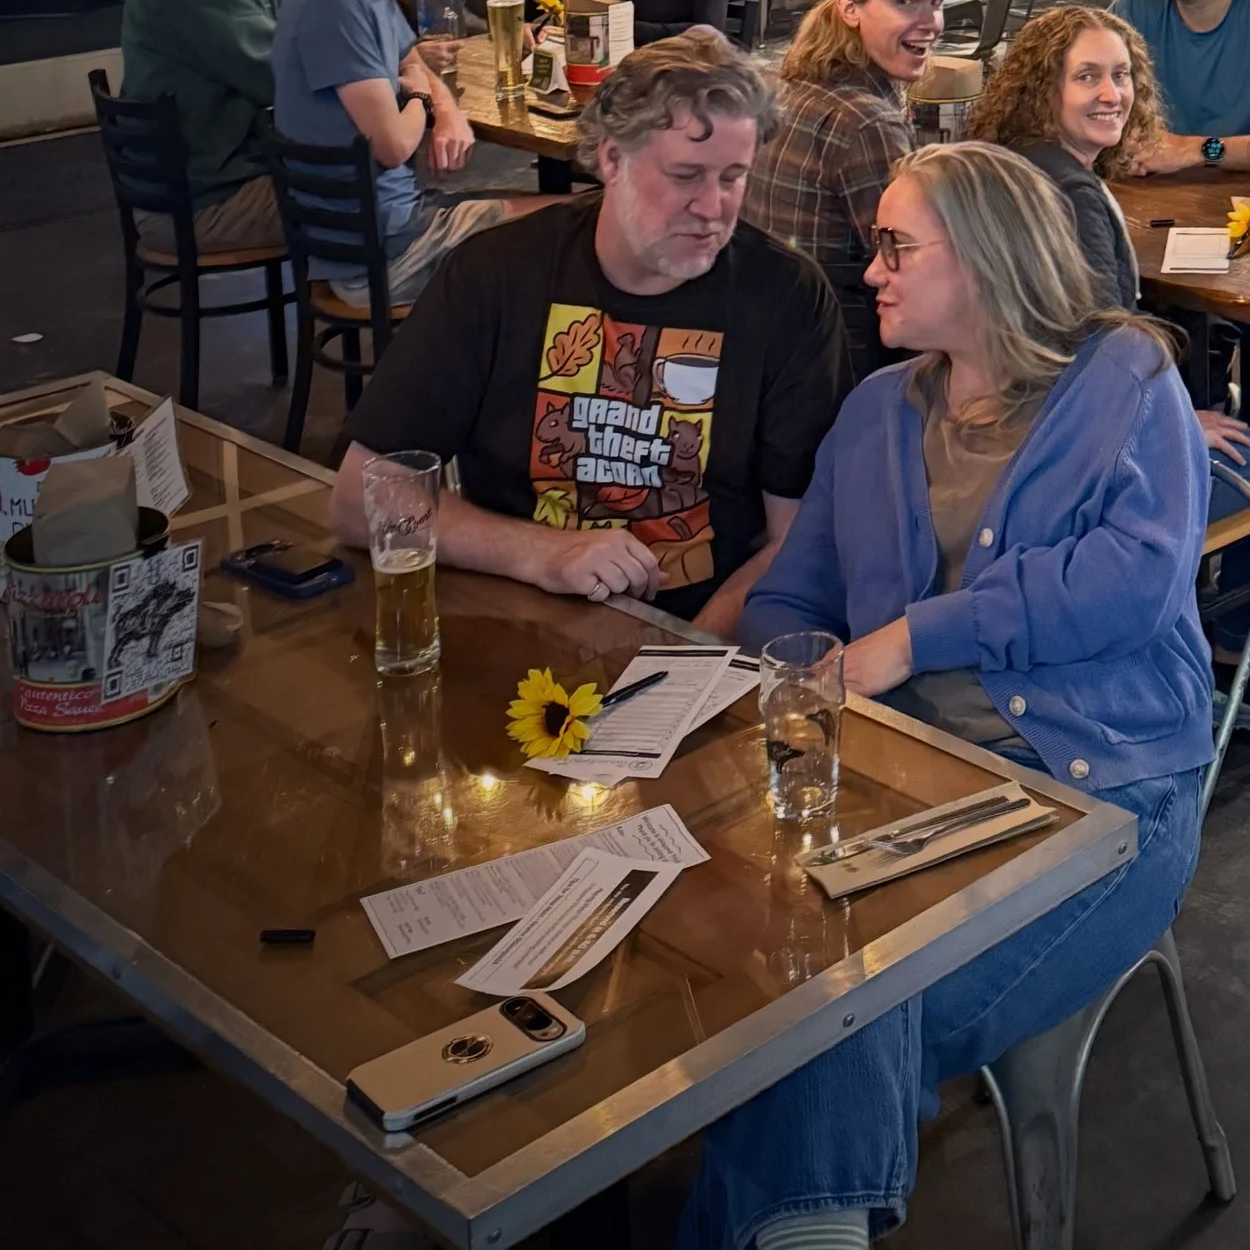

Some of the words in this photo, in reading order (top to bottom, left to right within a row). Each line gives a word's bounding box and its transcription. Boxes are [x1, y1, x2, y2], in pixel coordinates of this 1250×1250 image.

[572, 396, 661, 434] grand
[588, 425, 672, 467] theft
[576, 457, 662, 488] acorn
